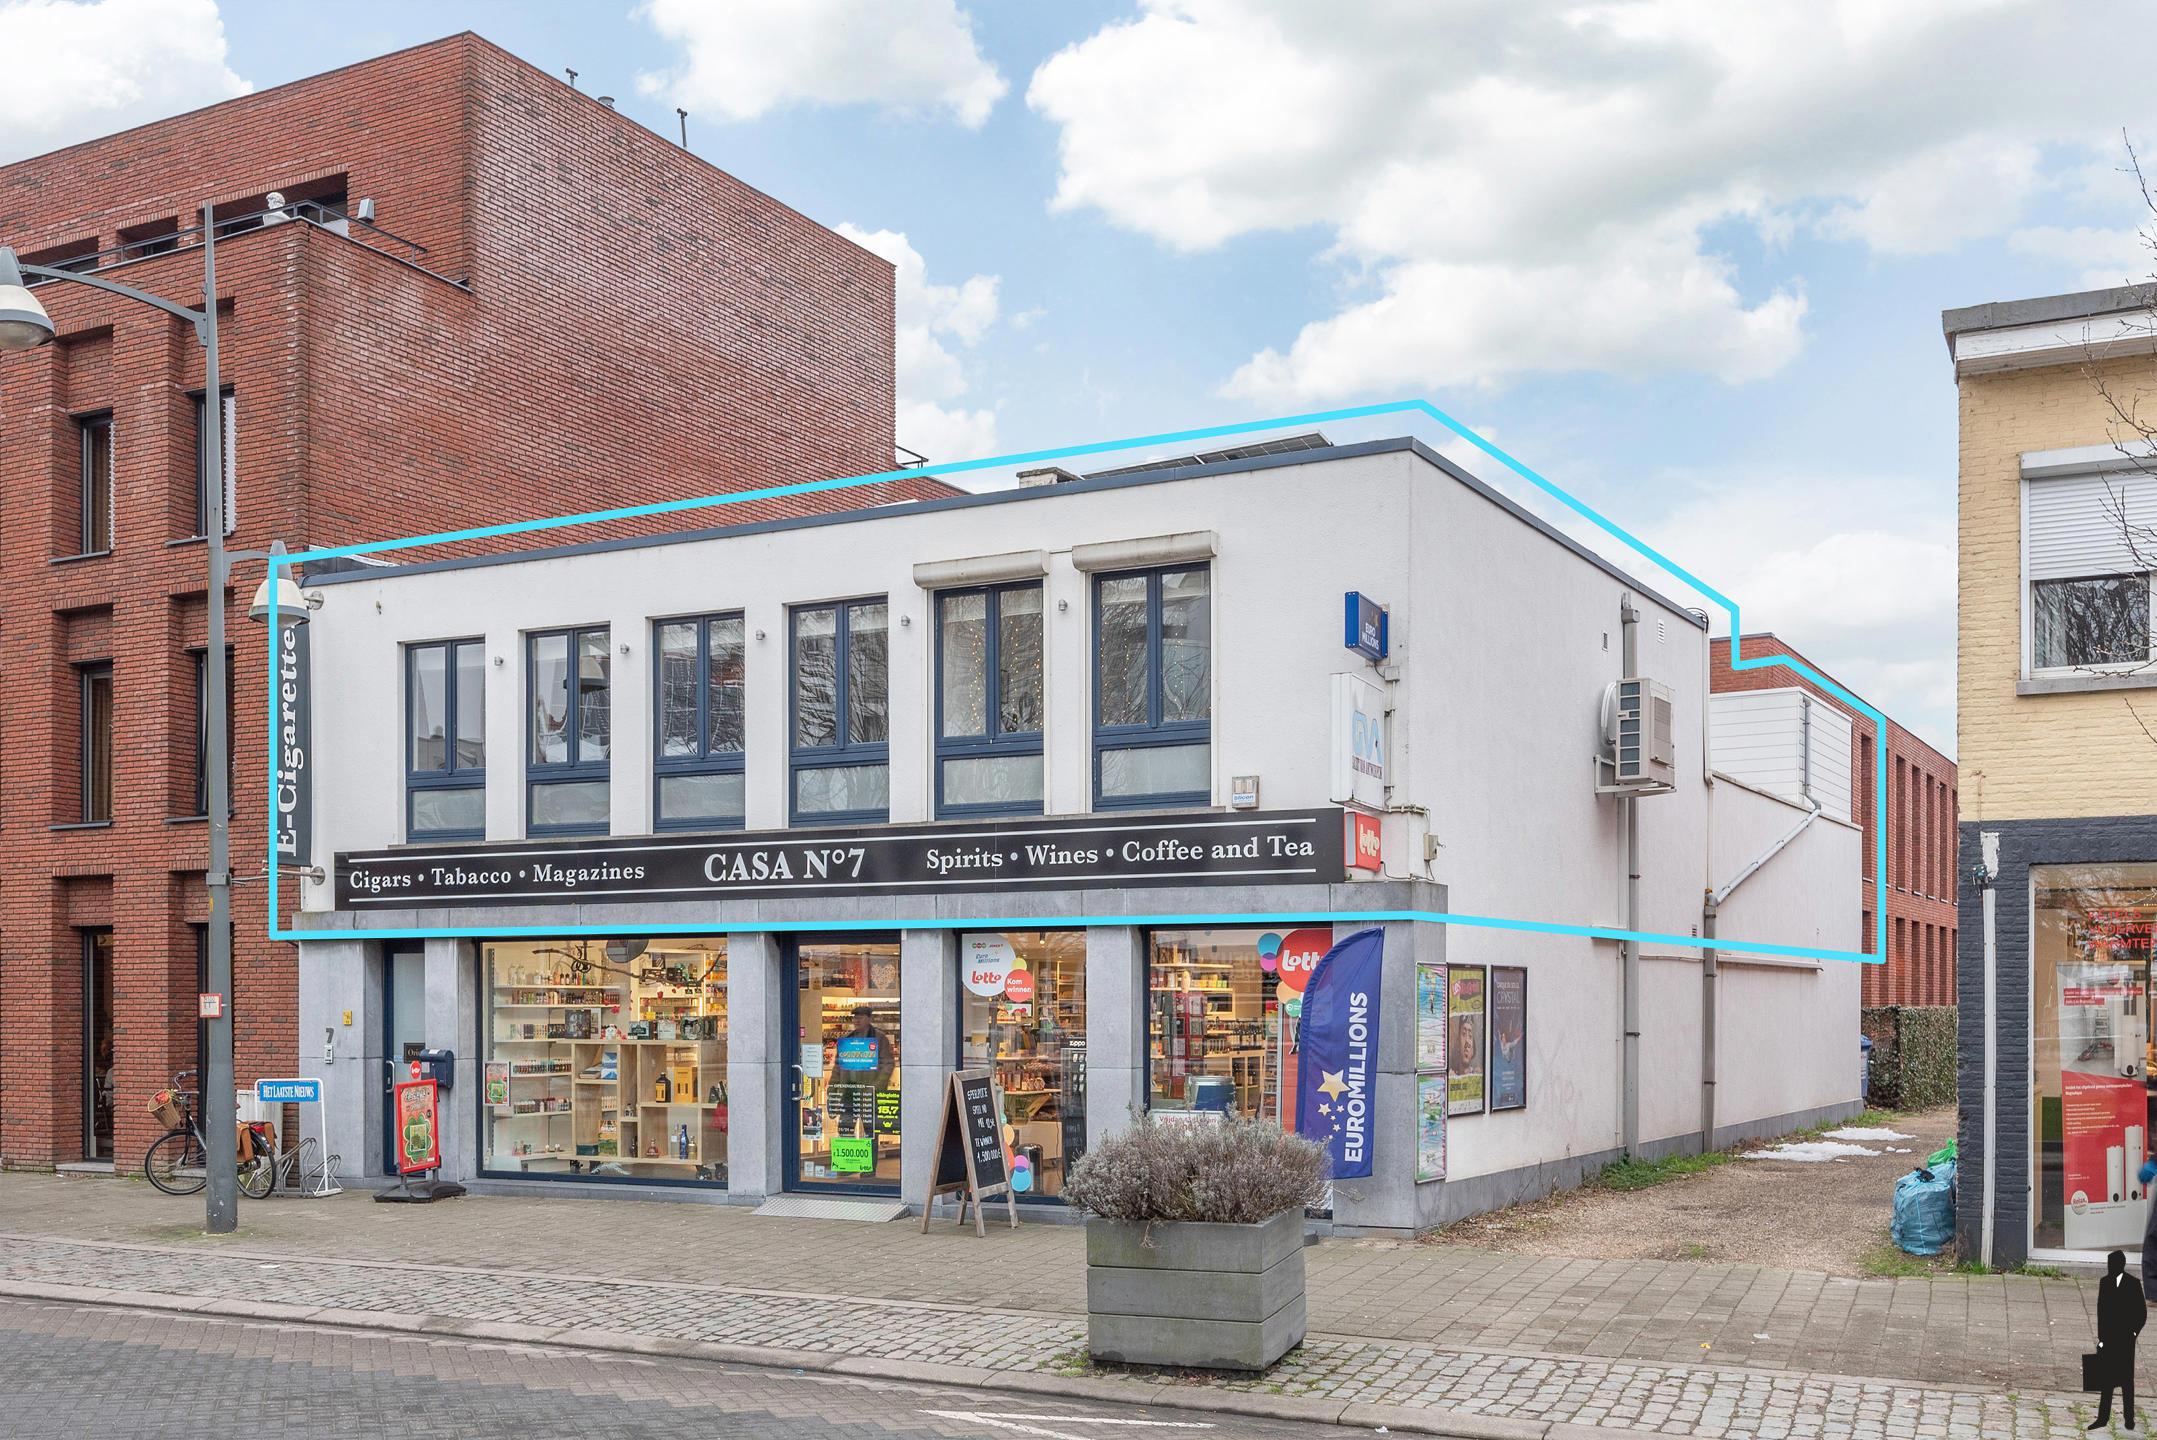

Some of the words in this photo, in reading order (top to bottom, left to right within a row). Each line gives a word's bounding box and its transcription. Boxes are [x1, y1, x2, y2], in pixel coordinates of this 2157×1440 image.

[277, 623, 303, 857] E-Cigarette
[704, 850, 794, 882] CASA
[927, 847, 1002, 875] Spirits
[1025, 844, 1098, 866] Wines
[1122, 839, 1203, 862] Coffee
[1211, 837, 1259, 859] and
[1267, 835, 1315, 857] Tea
[350, 870, 411, 893] Cigars
[431, 867, 511, 886] Tabacco
[533, 861, 645, 887] Magazines
[1282, 949, 1324, 971] Lott
[972, 970, 1002, 984] Lotto
[325, 1028, 334, 1043] 7
[1344, 992, 1368, 1163] EUROMILLIONS
[878, 1106, 899, 1115] 15,7
